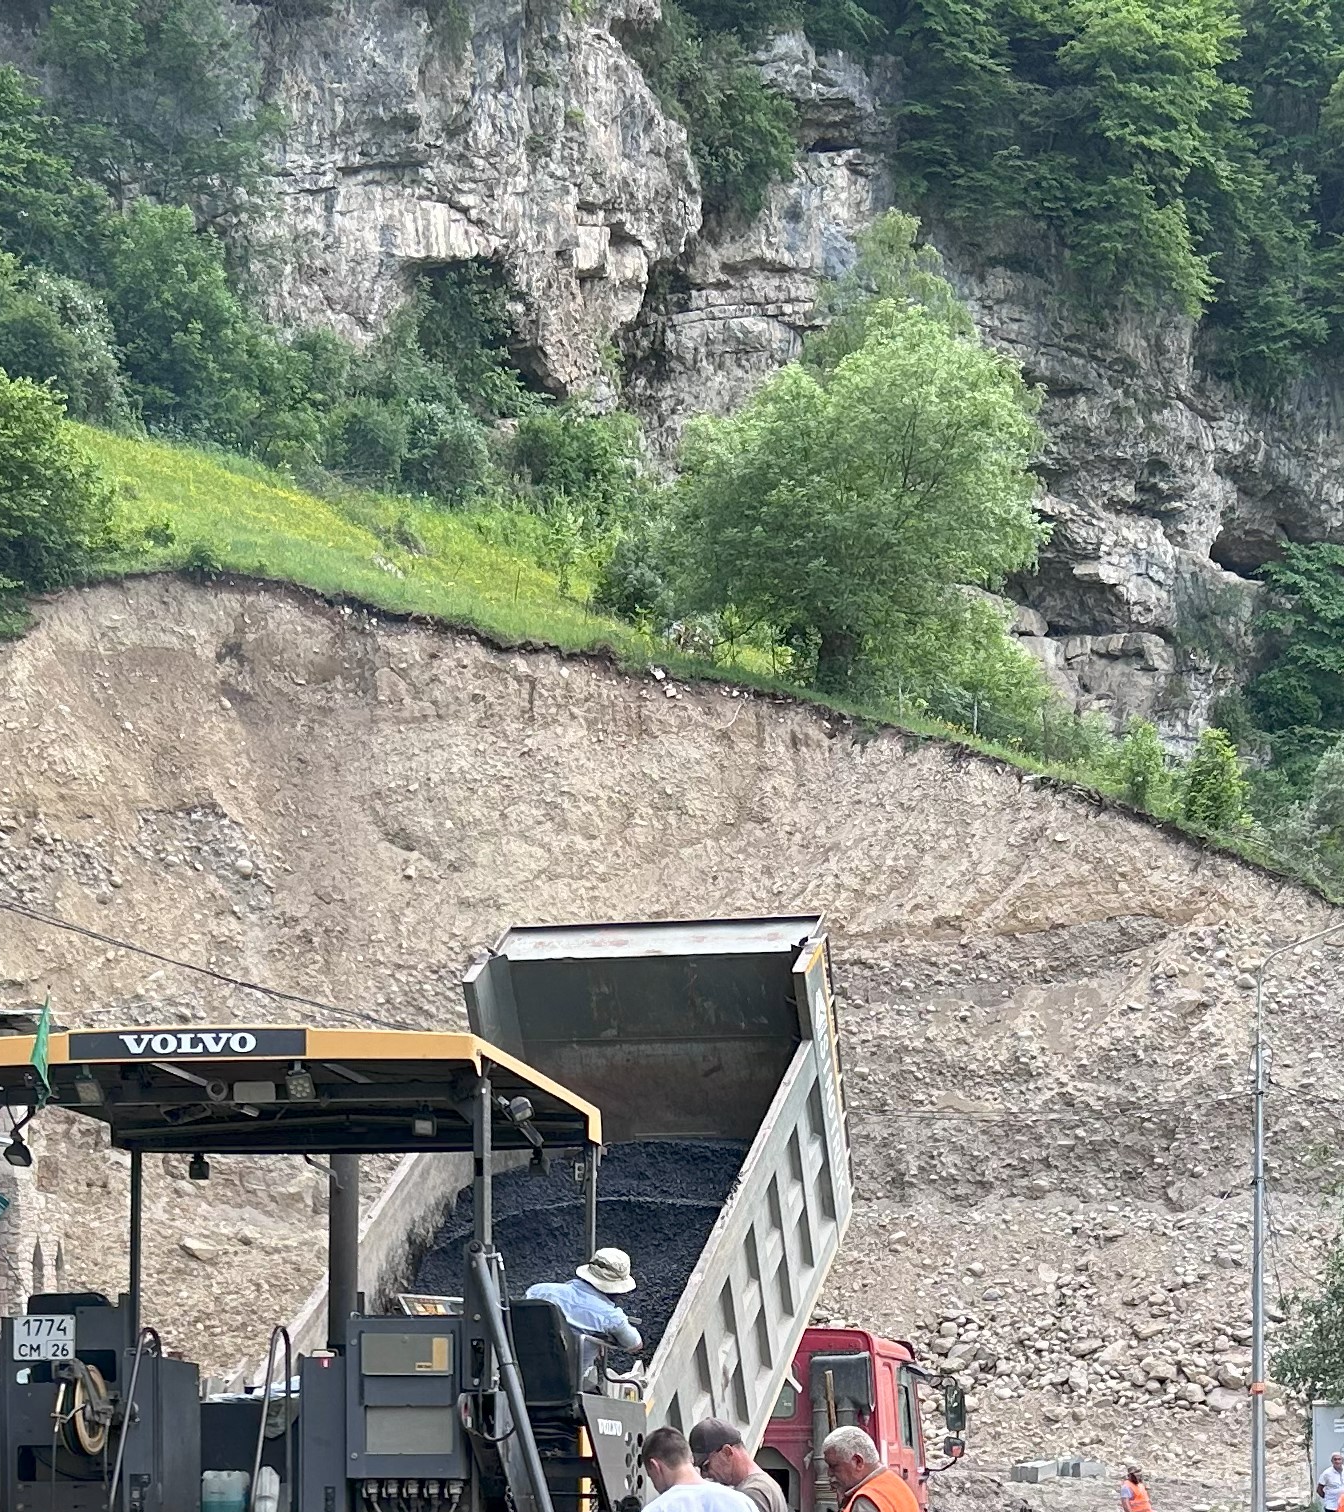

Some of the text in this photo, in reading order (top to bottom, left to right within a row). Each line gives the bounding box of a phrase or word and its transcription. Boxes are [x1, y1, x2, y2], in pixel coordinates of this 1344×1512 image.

[119, 1032, 257, 1054] VOLVO
[819, 1032, 847, 1201] SINOTRUK
[22, 1318, 67, 1337] 1774
[51, 1343, 69, 1357] 26
[597, 1418, 623, 1437] VOLVO
